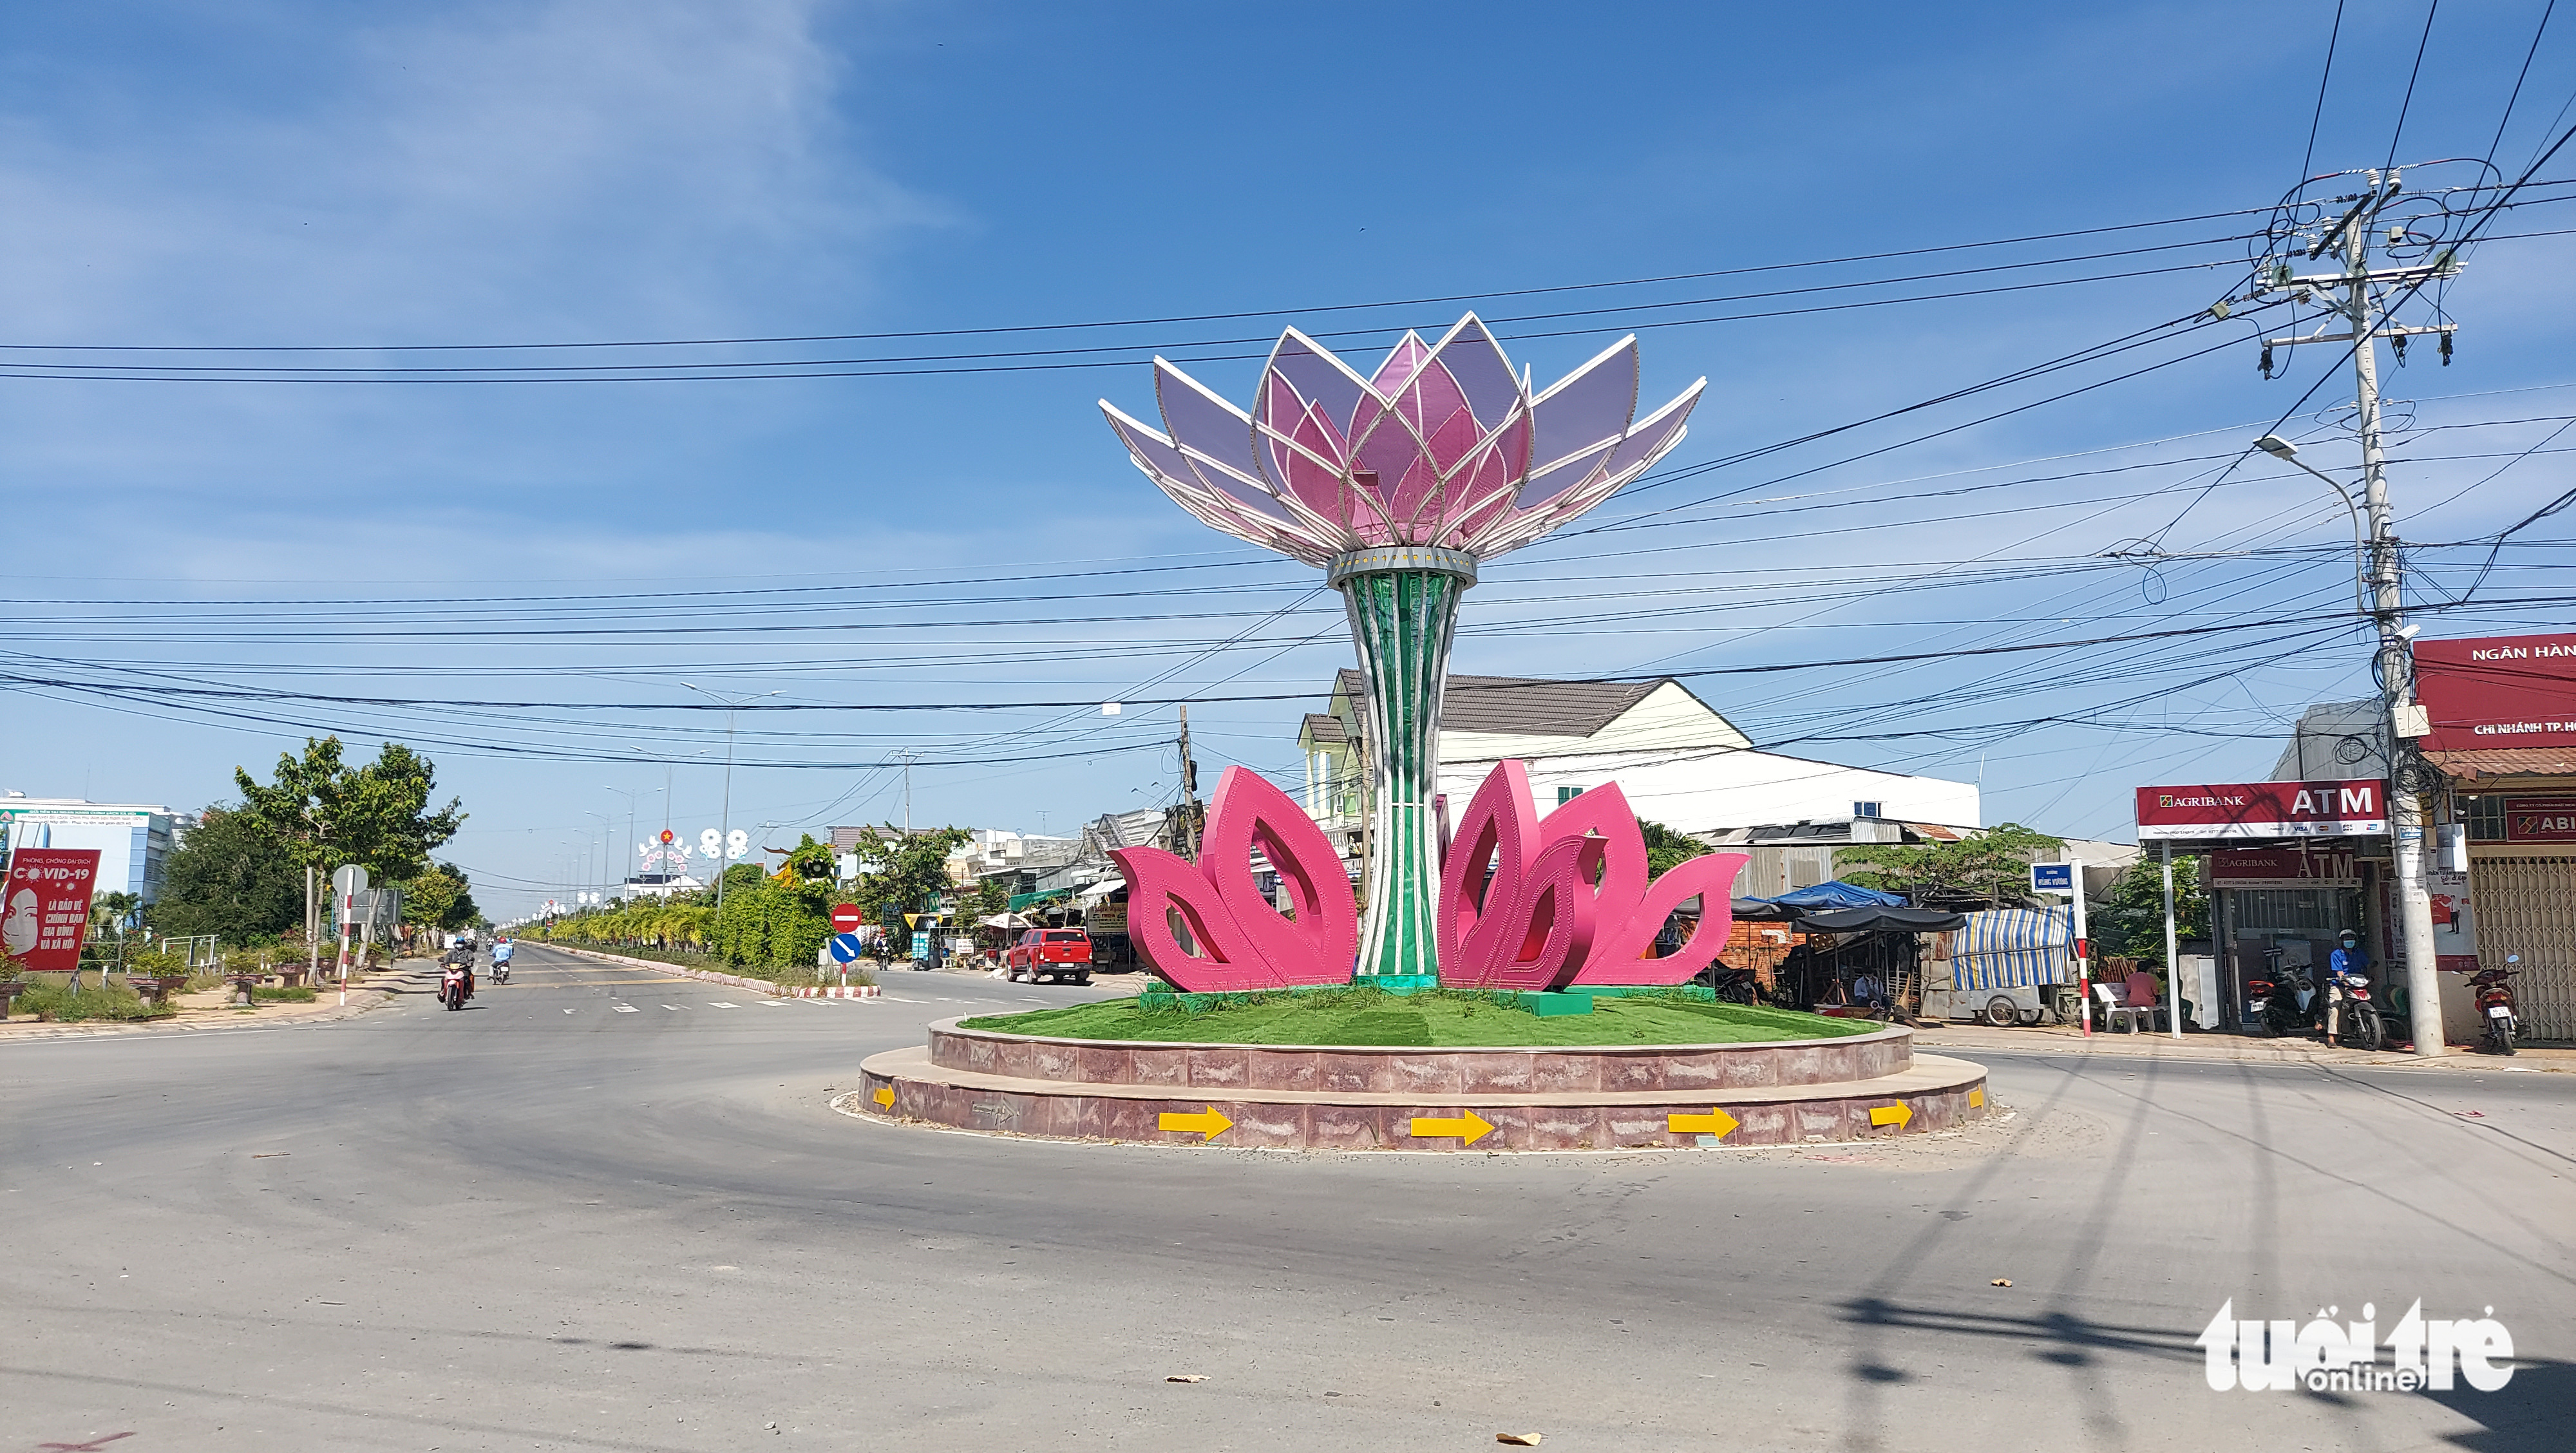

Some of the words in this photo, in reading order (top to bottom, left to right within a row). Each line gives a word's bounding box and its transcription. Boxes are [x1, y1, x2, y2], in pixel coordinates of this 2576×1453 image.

[2472, 645, 2527, 661] NGÂN
[2535, 643, 2576, 658] HÀN
[2497, 721, 2543, 734] NHÁNH
[2545, 721, 2576, 732] TP.H
[2174, 795, 2246, 807] AGRIBANK
[2291, 787, 2373, 815] ATM
[2229, 859, 2278, 867] AGRIBANK
[2297, 853, 2355, 878] ATM
